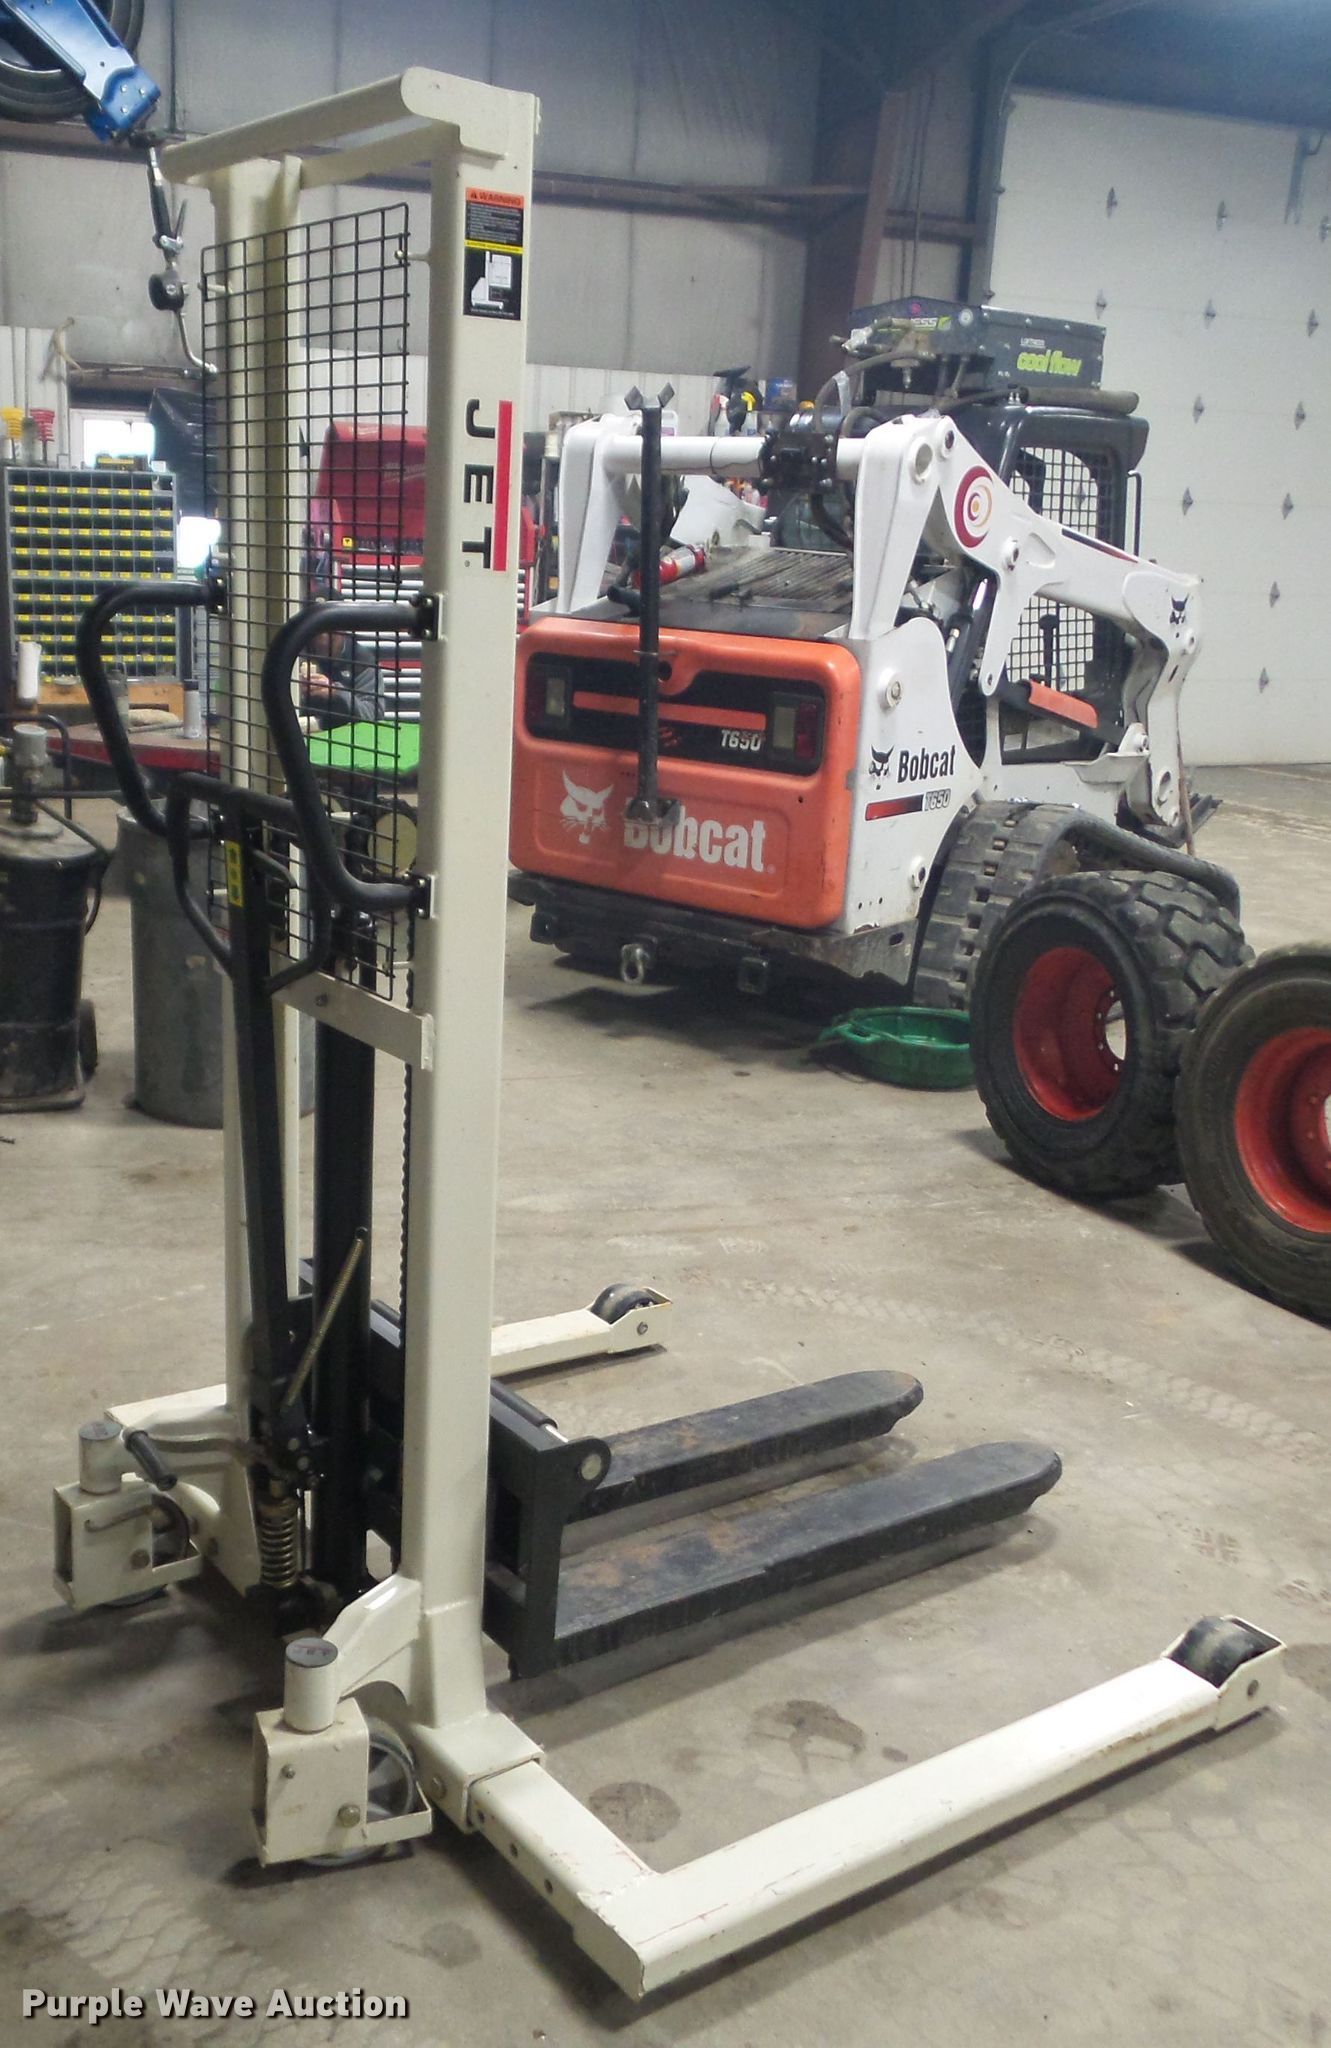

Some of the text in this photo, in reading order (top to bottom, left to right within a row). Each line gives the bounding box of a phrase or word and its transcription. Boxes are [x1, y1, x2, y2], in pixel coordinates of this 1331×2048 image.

[479, 191, 521, 206] WARNING
[461, 398, 496, 569] JET
[721, 729, 763, 751] T650
[897, 745, 956, 783] Bobcat
[924, 788, 952, 812] T650
